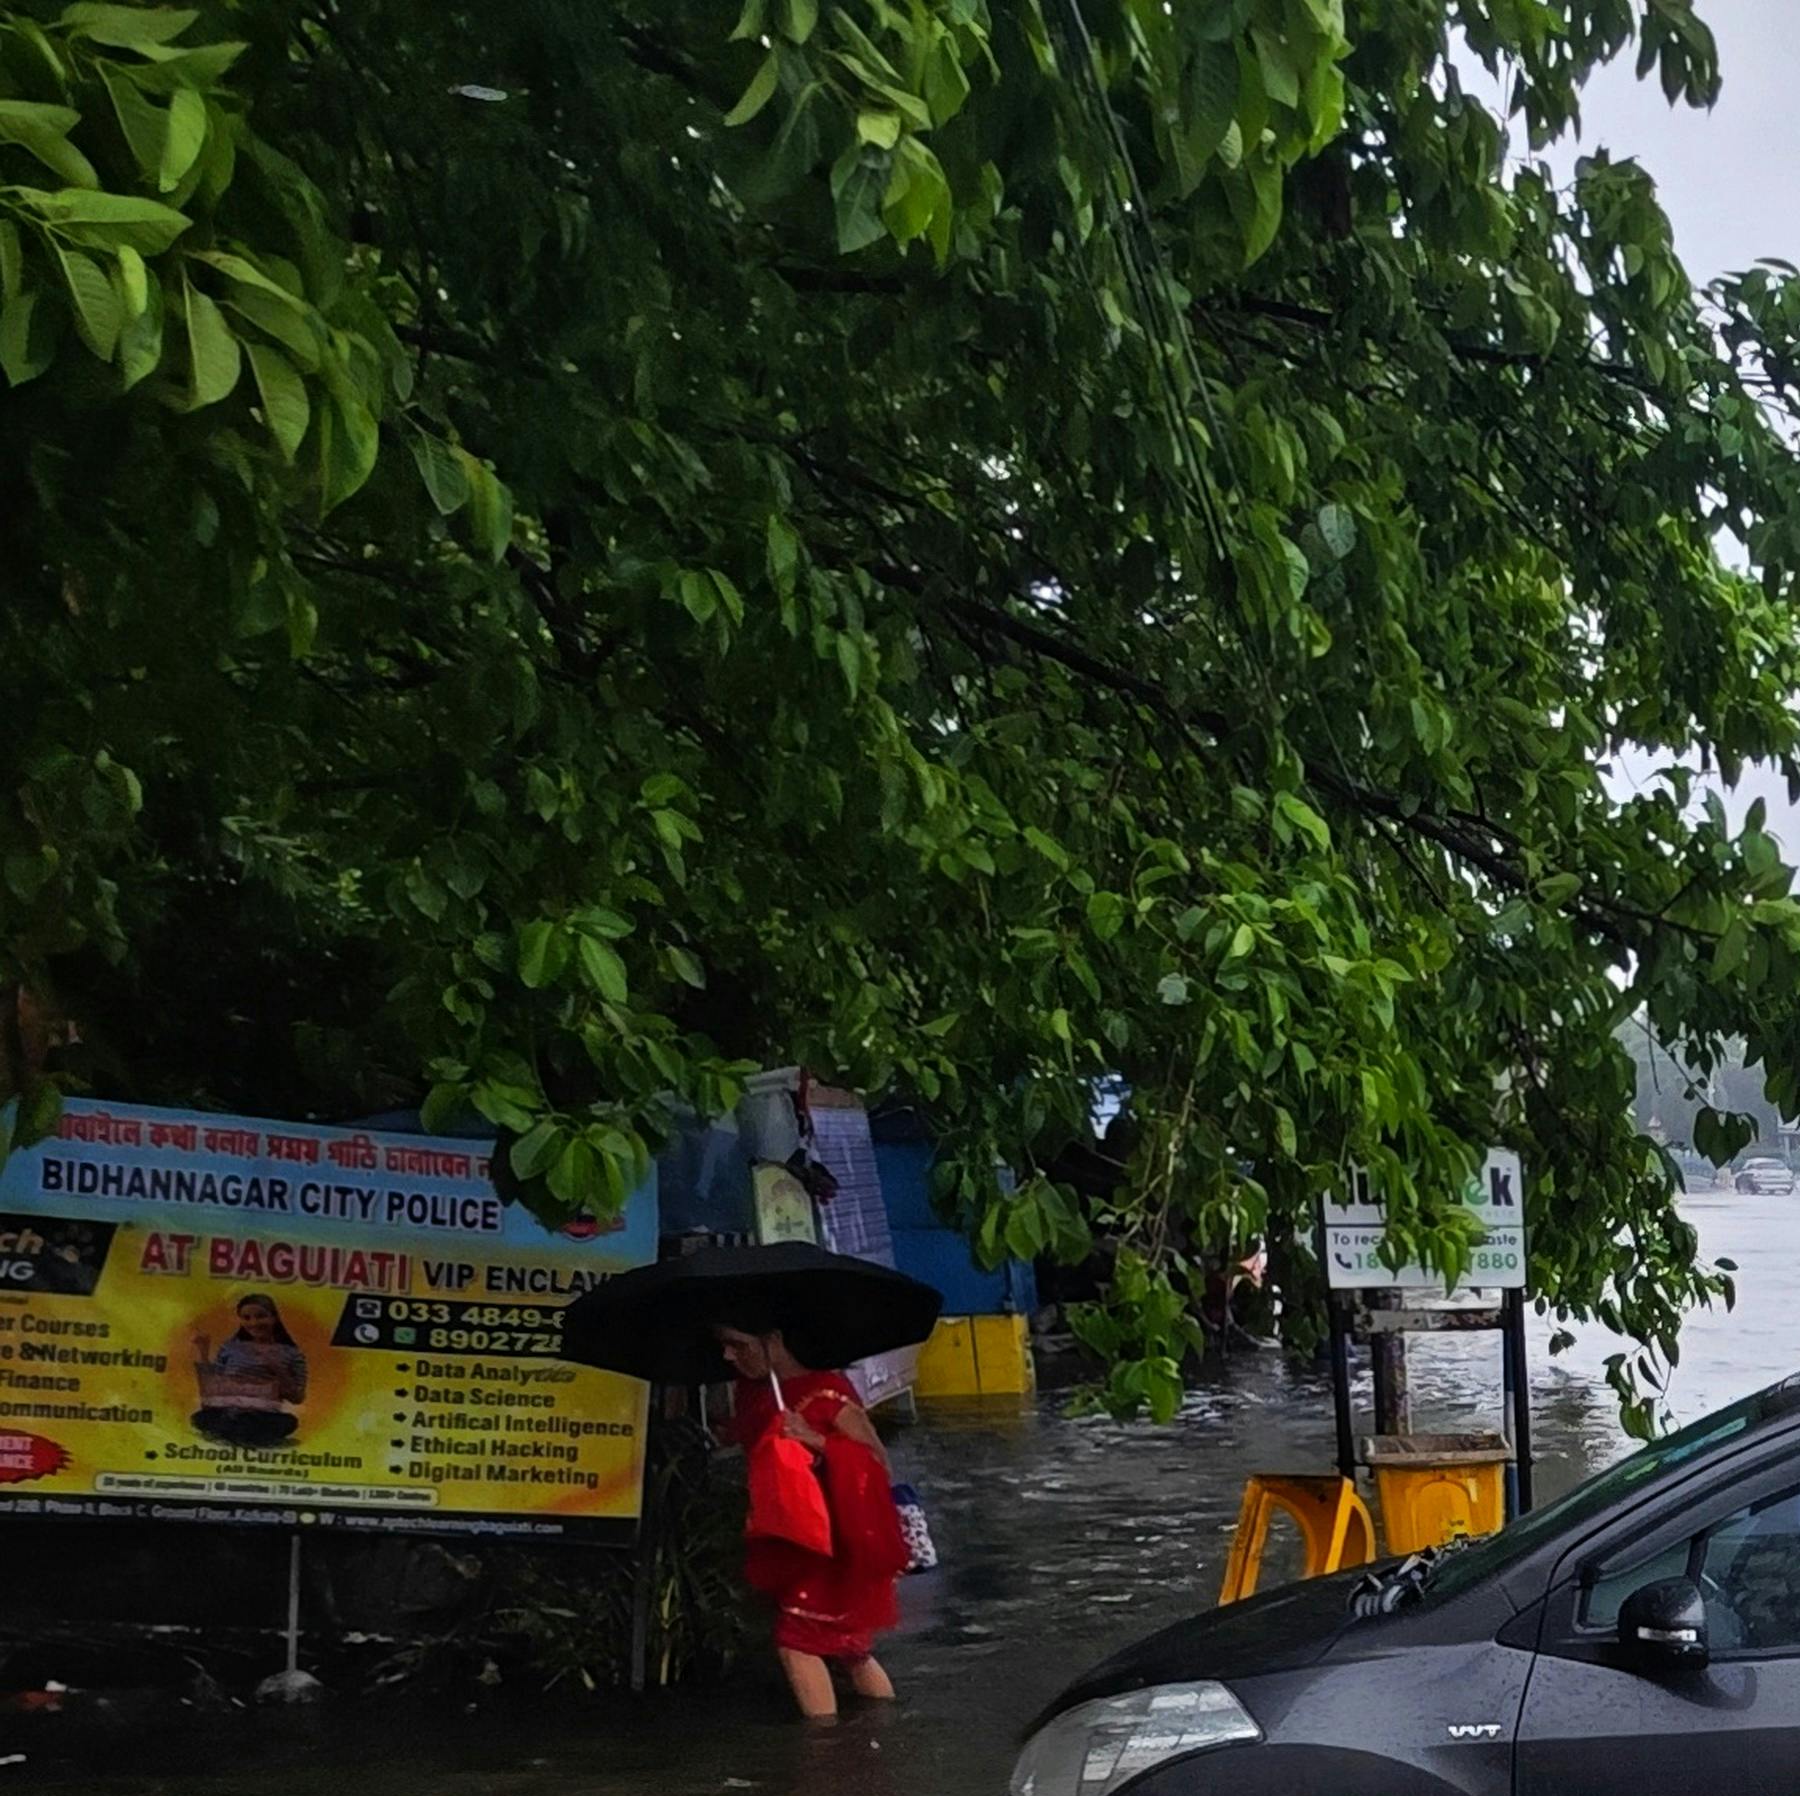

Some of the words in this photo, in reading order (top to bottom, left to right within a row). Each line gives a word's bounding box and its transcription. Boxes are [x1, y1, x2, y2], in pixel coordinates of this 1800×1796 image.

[41, 1157, 289, 1211] BIDHANNAGAR
[300, 1182, 376, 1219] CITY
[387, 1190, 499, 1230] POLICE
[1333, 1232, 1349, 1246] To
[141, 1232, 195, 1272] AT
[210, 1236, 408, 1291] BAGUIATI
[422, 1260, 474, 1290] VIP
[20, 1313, 111, 1338] Courses
[387, 1301, 450, 1326] 033
[42, 1343, 168, 1373] Networking
[416, 1360, 465, 1380] Data
[414, 1385, 465, 1405] Data
[469, 1388, 556, 1409] Science
[0, 1401, 153, 1424] ommunication
[506, 1414, 635, 1439] Intelligence
[164, 1442, 237, 1462] School
[242, 1447, 363, 1469] Curriculum
[410, 1435, 486, 1456] Ethical
[491, 1438, 579, 1463] Hacking
[408, 1461, 482, 1483] Digital
[486, 1464, 600, 1490] Marketing
